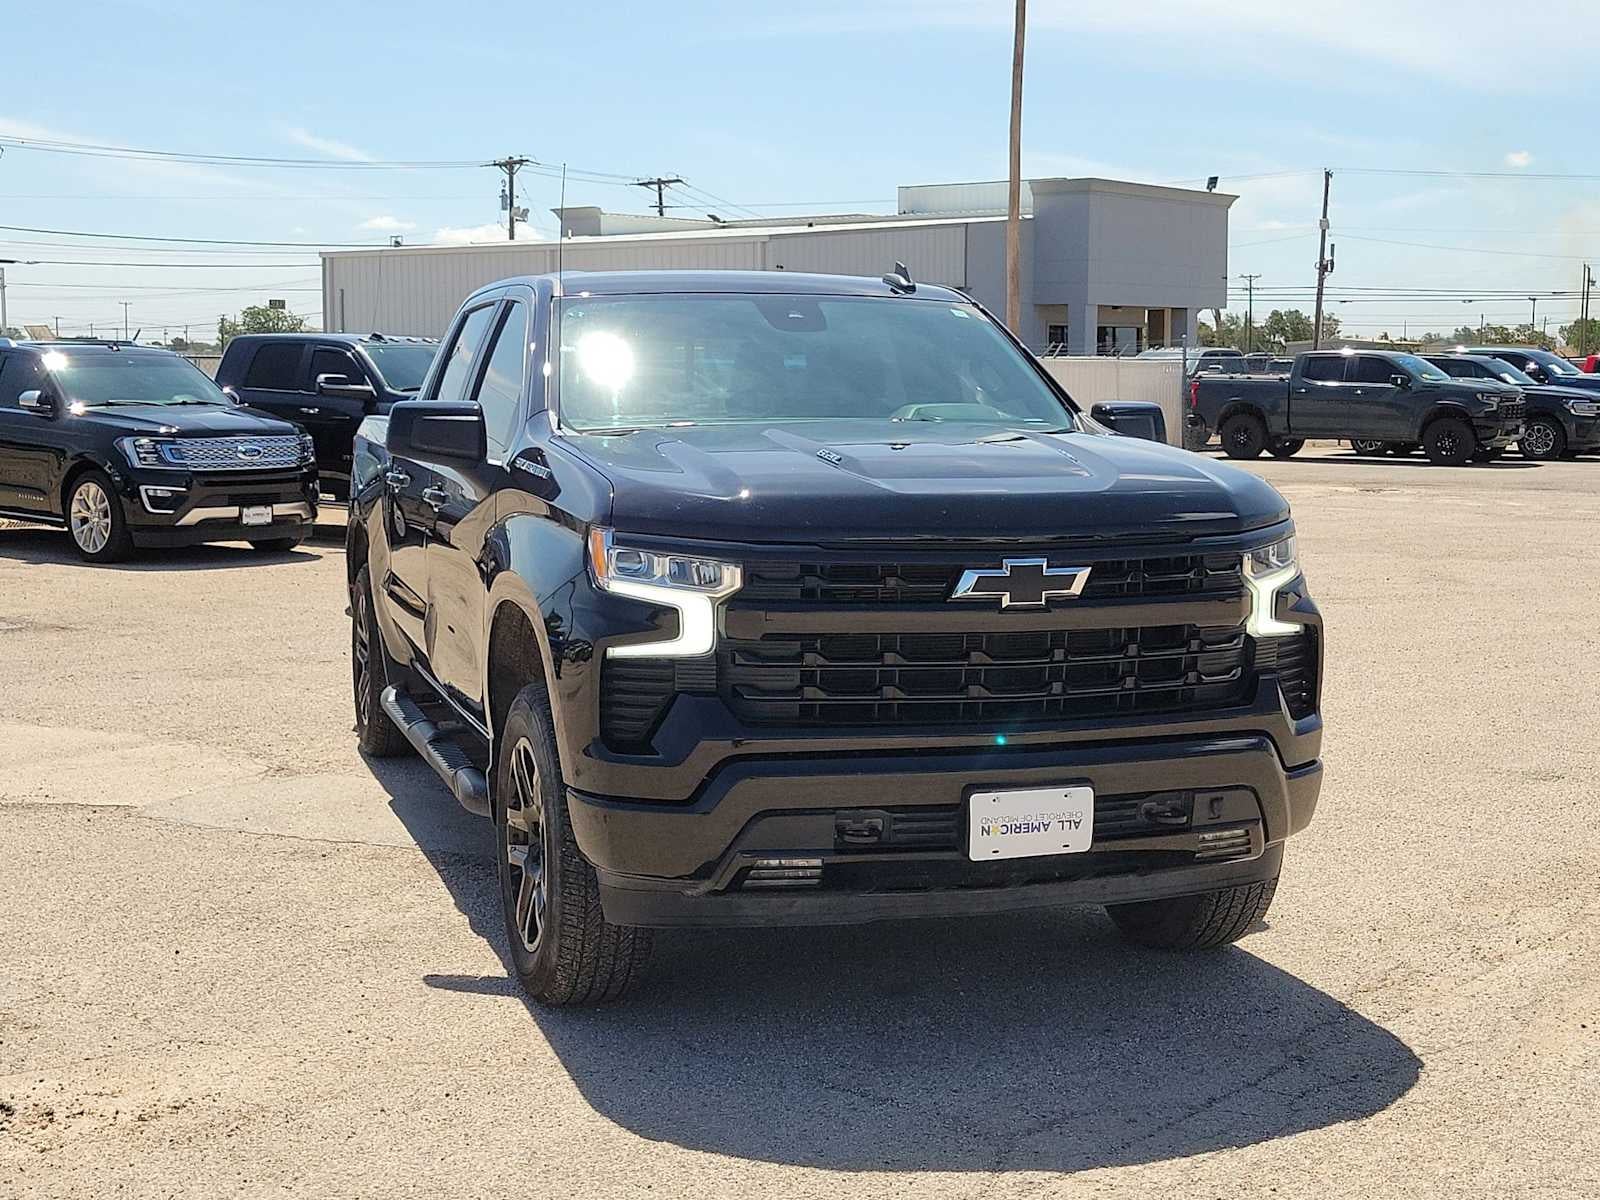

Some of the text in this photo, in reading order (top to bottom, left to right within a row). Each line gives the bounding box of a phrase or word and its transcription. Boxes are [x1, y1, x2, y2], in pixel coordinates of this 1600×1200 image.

[980, 811, 1083, 825] CHEVROLET OF MIDLAND
[1057, 818, 1082, 831] ALL
